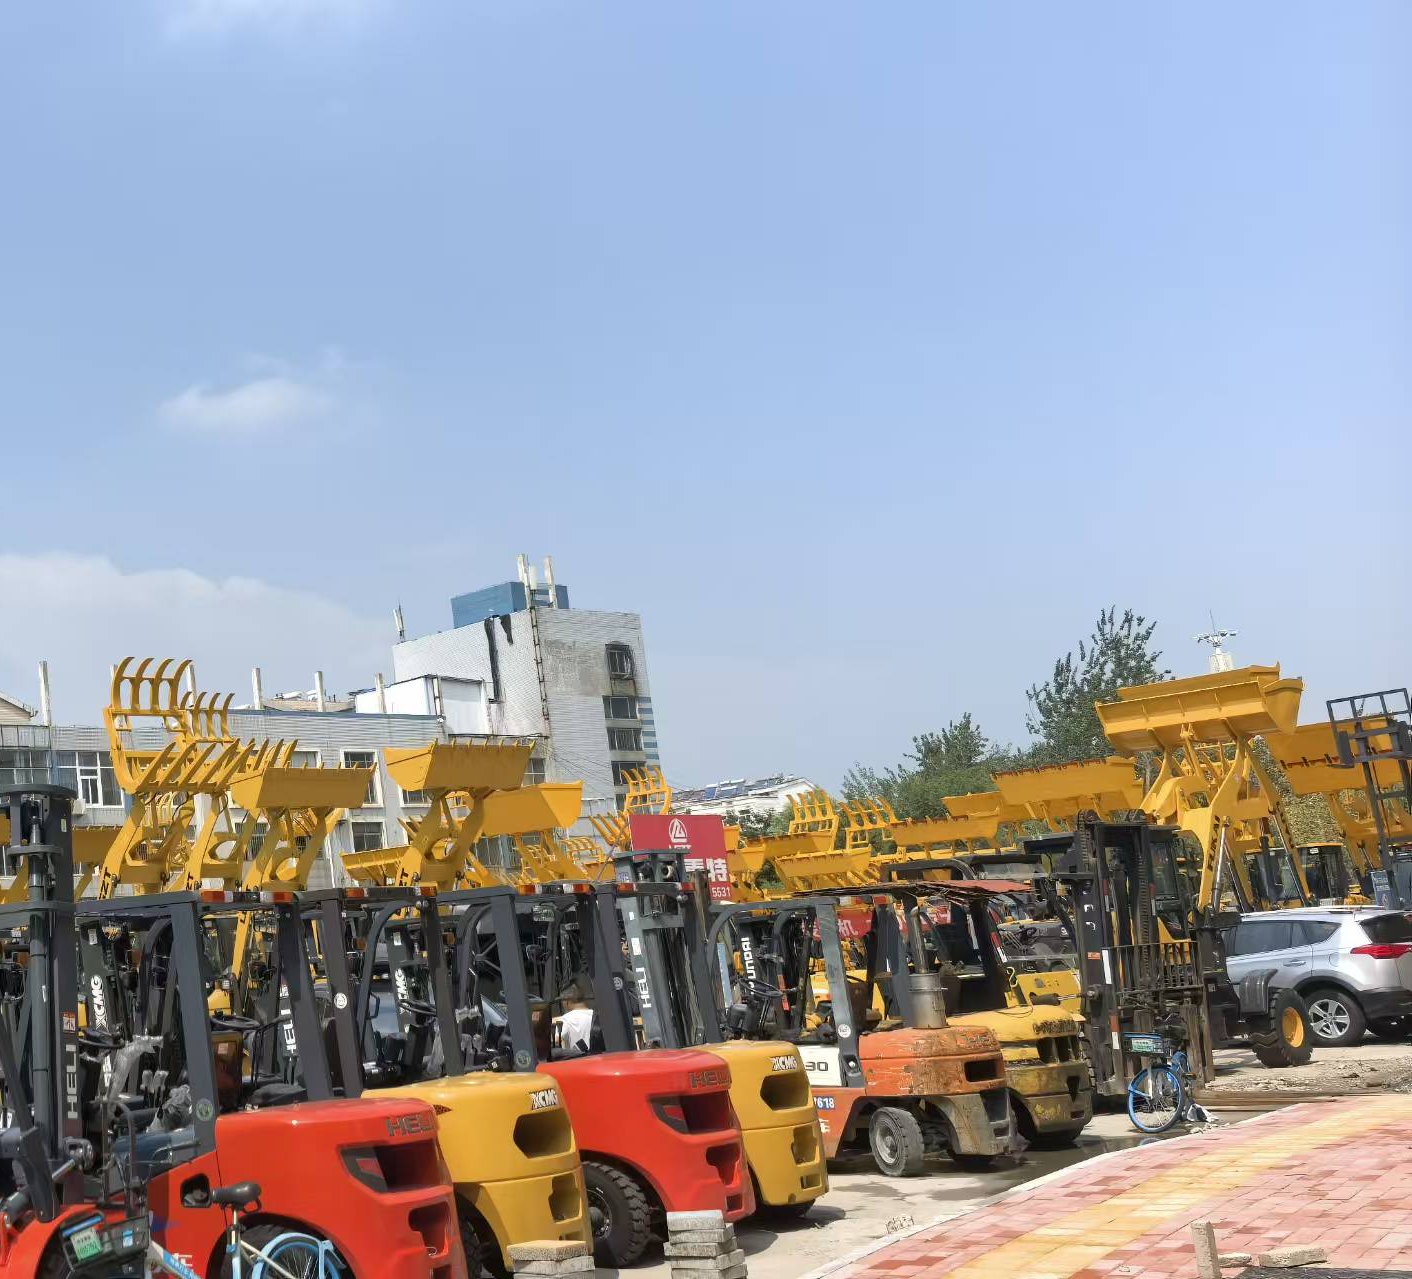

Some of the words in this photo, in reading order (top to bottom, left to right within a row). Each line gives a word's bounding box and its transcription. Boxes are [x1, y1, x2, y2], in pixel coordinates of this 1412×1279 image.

[90, 974, 109, 1032] XCMG
[635, 967, 652, 1009] HELI
[65, 1044, 78, 1119] HELI
[769, 1055, 798, 1072] XCMG
[529, 1087, 559, 1111] XCMG
